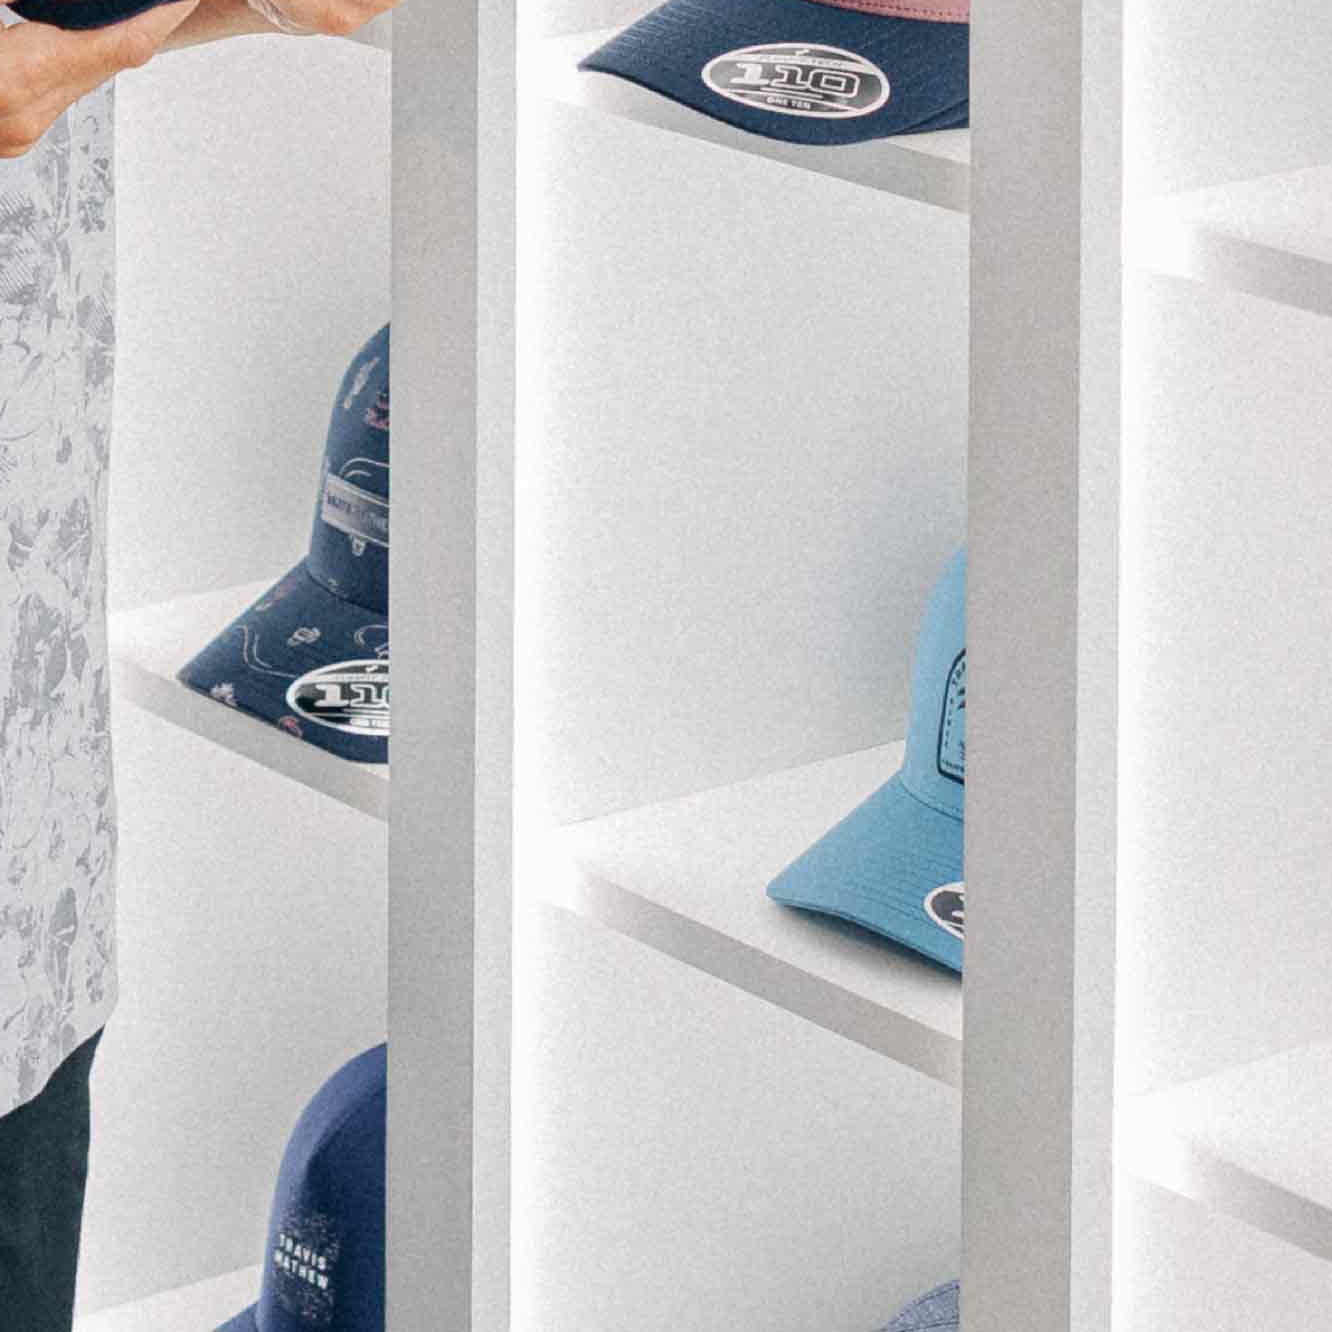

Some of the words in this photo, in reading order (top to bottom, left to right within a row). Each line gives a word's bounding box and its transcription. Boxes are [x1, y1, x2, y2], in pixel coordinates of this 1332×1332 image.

[729, 63, 860, 98] 110
[274, 1248, 329, 1290] MATHEW
[279, 1233, 327, 1271] TRAVIS
